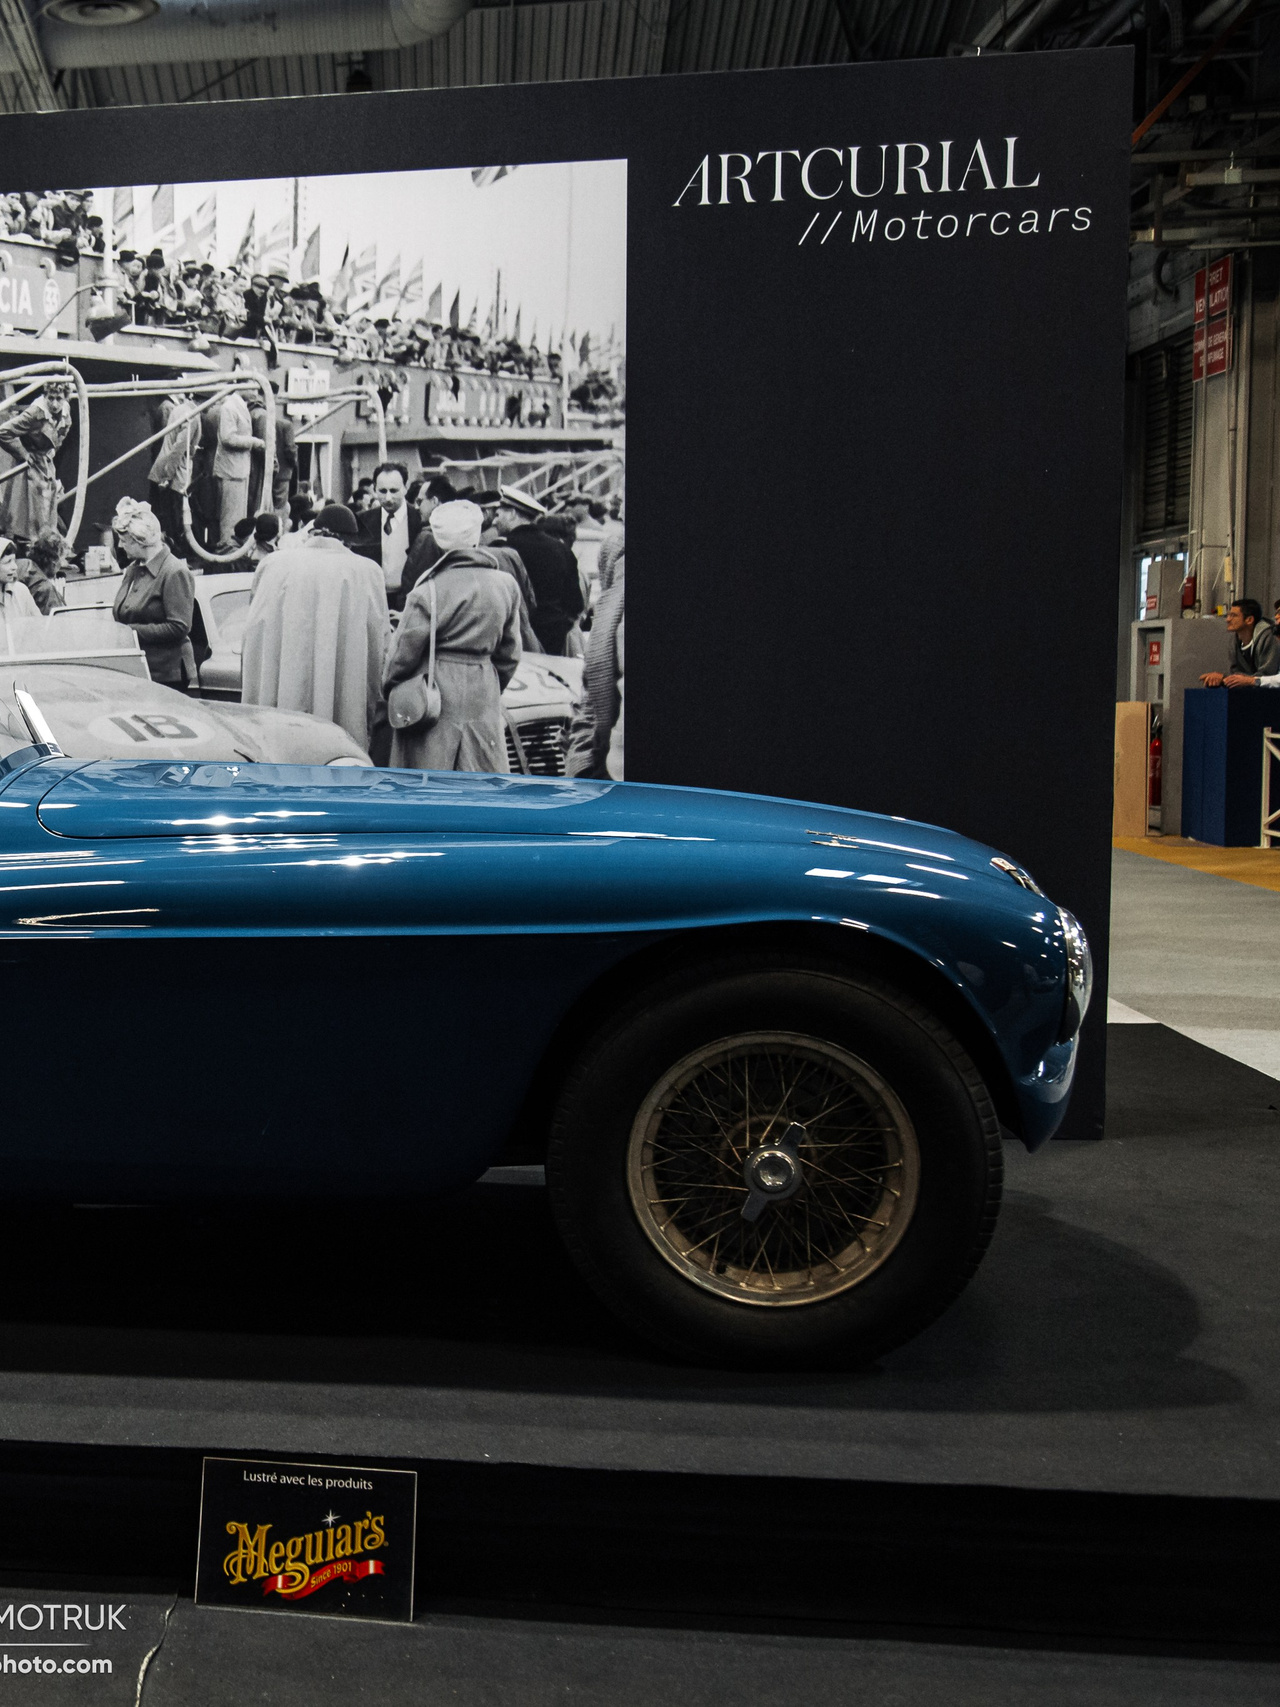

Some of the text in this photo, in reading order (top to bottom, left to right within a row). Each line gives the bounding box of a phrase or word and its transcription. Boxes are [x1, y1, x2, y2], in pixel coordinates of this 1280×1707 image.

[671, 137, 1041, 208] ARTCURIAL
[798, 205, 1093, 247] //Motorcars
[108, 714, 199, 743] 18
[243, 1470, 373, 1490] Lustré avec les produits
[223, 1510, 385, 1594] Meguiar's
[310, 1561, 352, 1589] Since 1901
